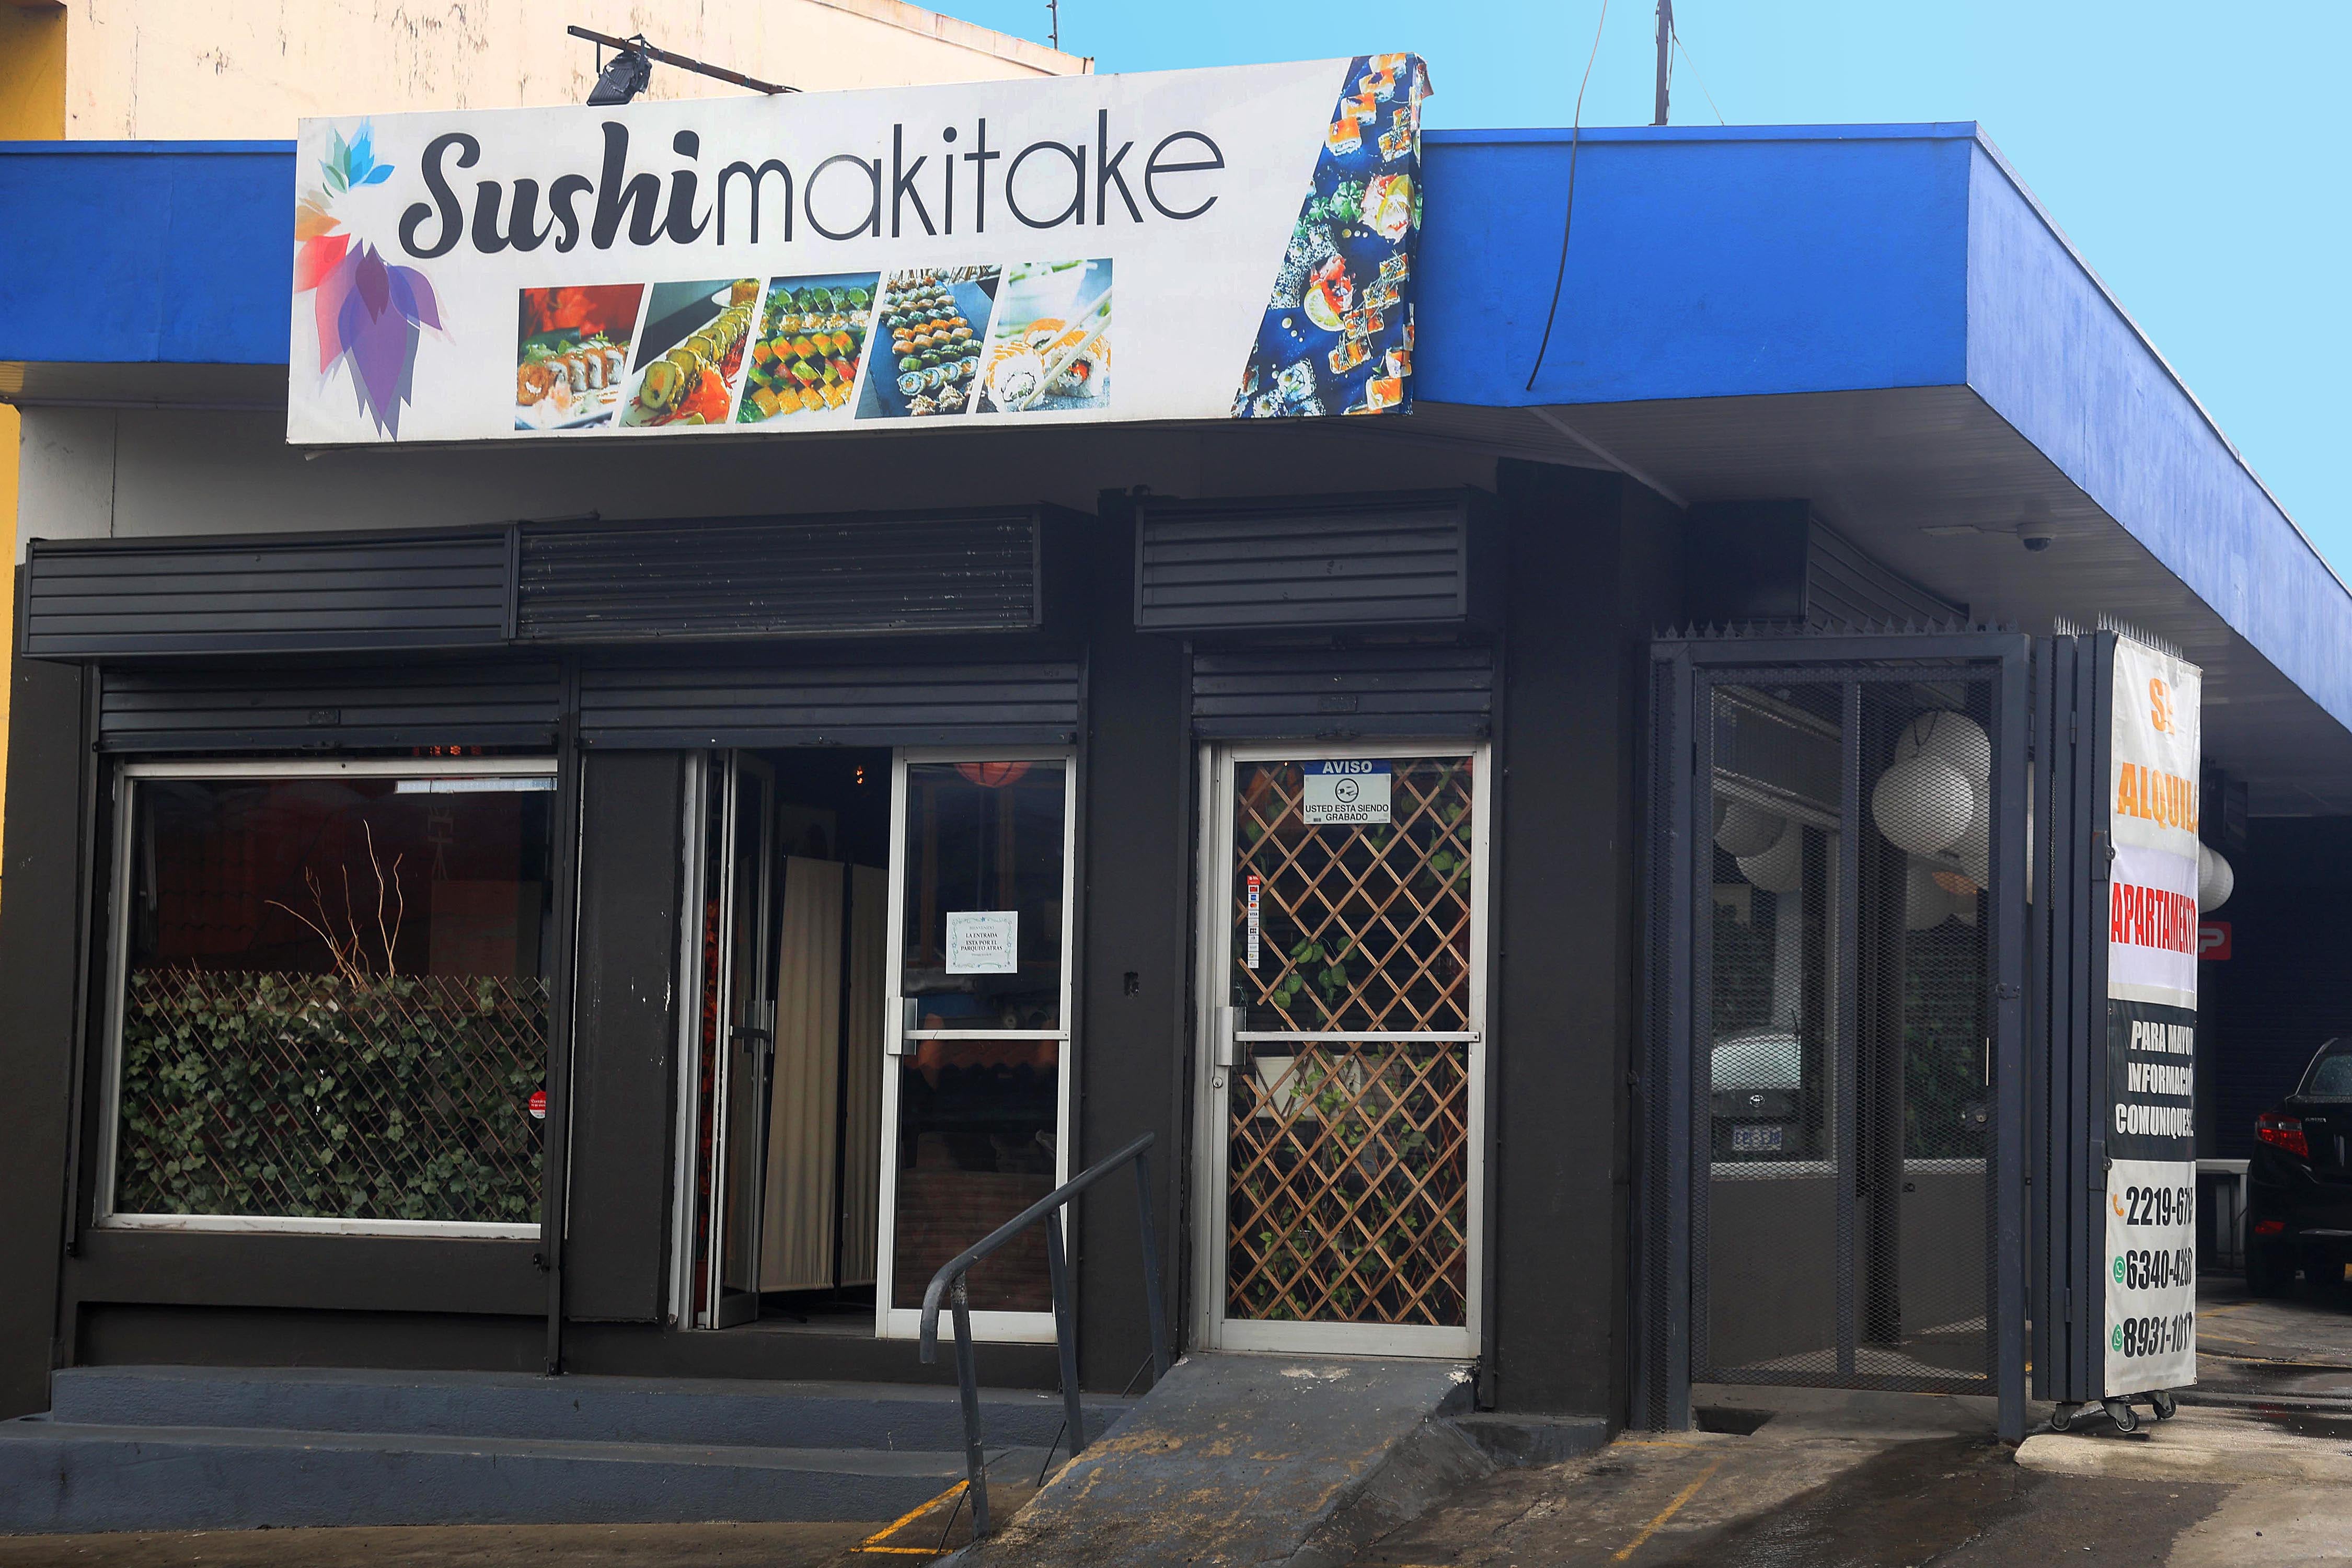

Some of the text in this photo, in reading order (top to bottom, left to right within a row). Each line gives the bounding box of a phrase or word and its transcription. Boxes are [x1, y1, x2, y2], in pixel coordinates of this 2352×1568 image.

[1322, 760, 1373, 774] AVISO
[1357, 804, 1389, 812] SIENDO
[1325, 813, 1368, 821] GRABADO
[2130, 1020, 2166, 1053] PARA
[2128, 1062, 2194, 1096] INFORMACIÓ
